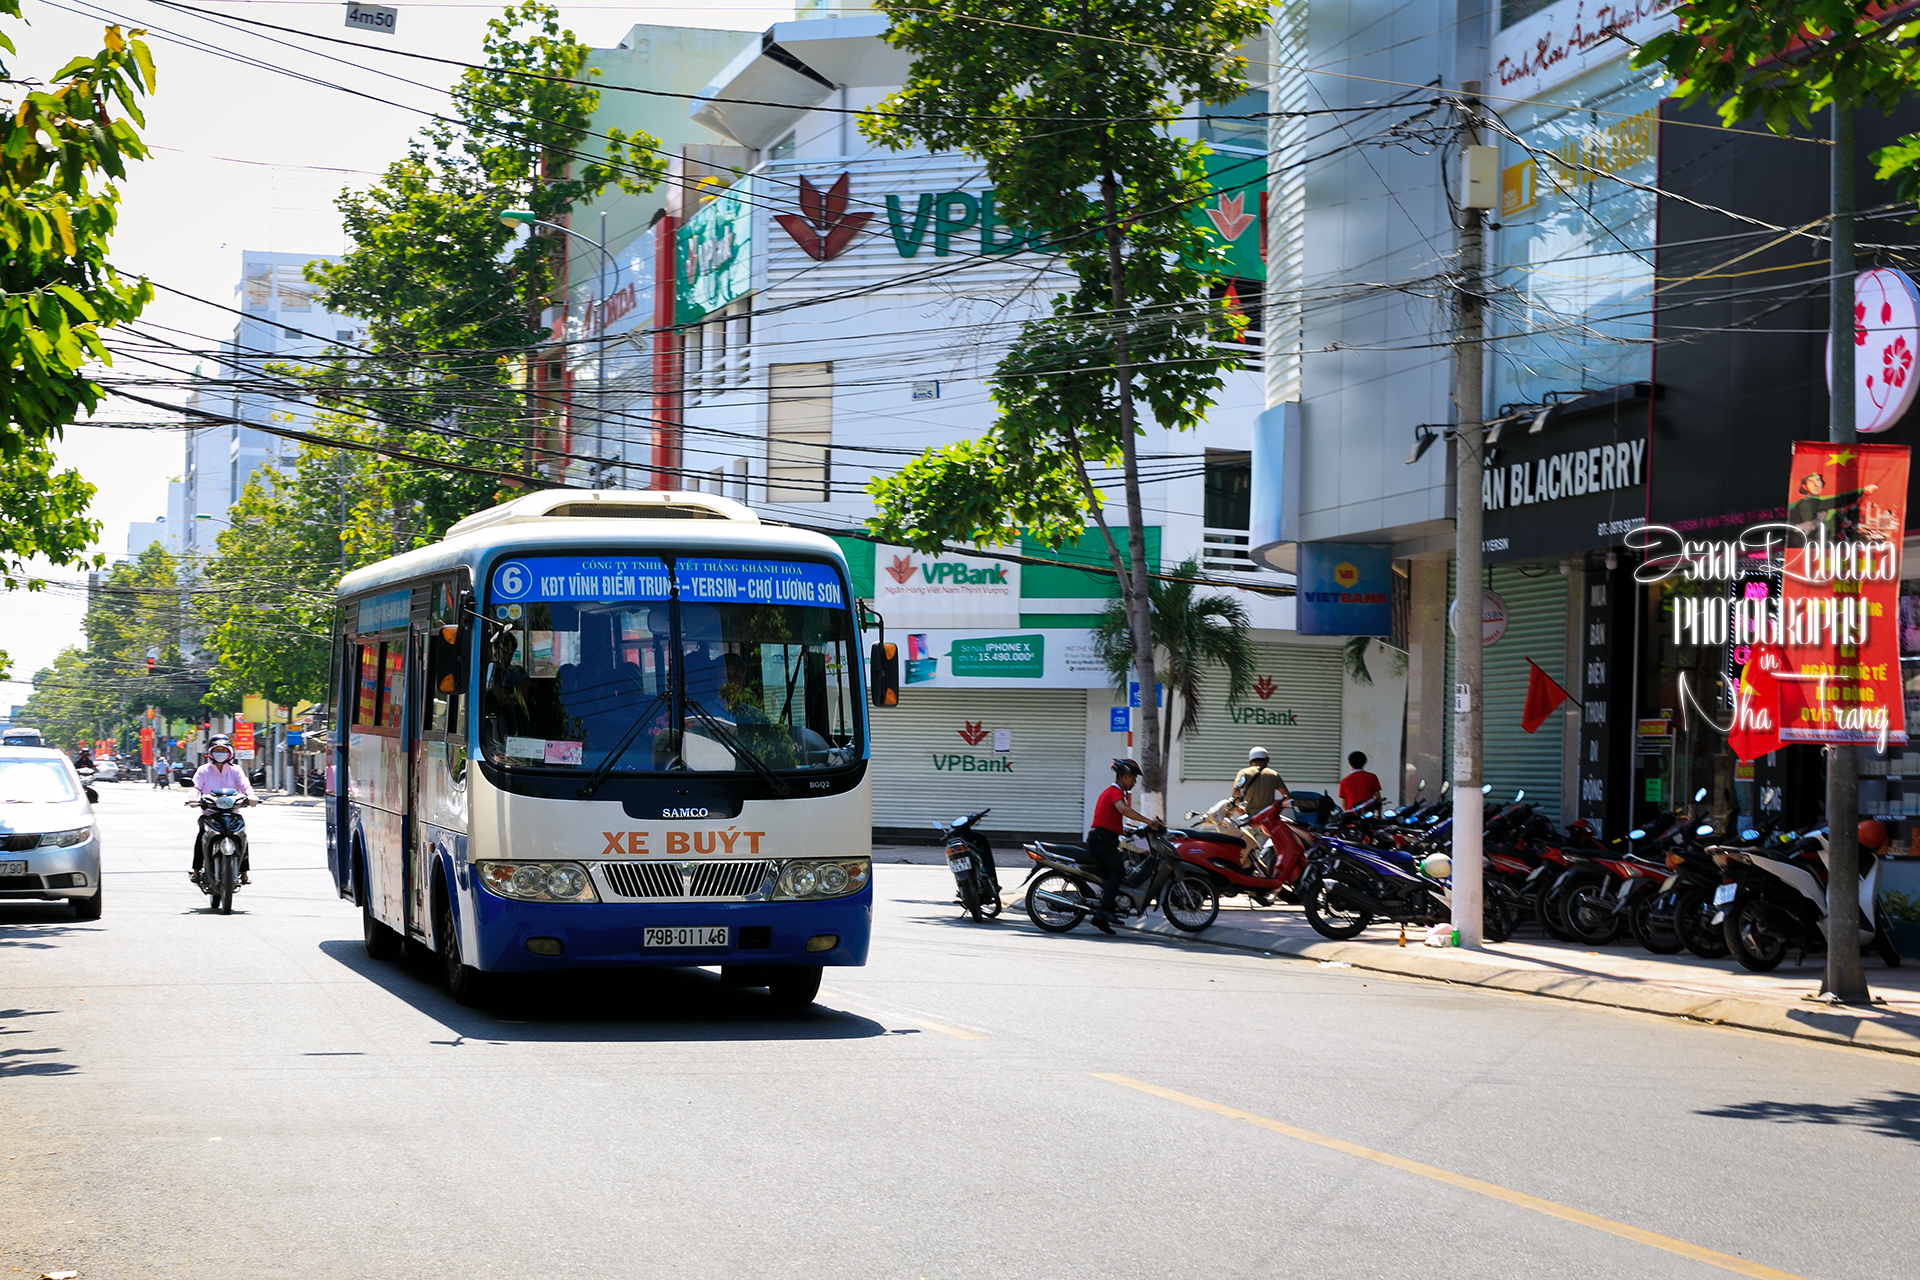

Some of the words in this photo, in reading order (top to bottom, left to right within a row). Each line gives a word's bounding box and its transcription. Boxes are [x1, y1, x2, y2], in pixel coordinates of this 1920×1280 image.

[349, 8, 394, 28] 4m50
[1510, 438, 1646, 506] BLACKBERRY
[582, 559, 612, 570] CÔNG
[615, 561, 628, 570] TY
[631, 561, 661, 570] TNHH
[702, 559, 739, 572] THẮNG
[741, 562, 778, 574] KHÁNH
[781, 564, 803, 575] HÒA
[922, 563, 1009, 585] VPBank
[1338, 569, 1355, 580] VB
[502, 566, 523, 594] 6
[541, 576, 565, 596] KĐT
[568, 572, 599, 596] VĨNH
[691, 577, 737, 598] YERSIN
[747, 576, 773, 604] CHỢ
[776, 578, 815, 602] LƯƠNG
[818, 581, 841, 604] SƠN
[1304, 592, 1389, 604] VIETBANK
[985, 643, 1022, 652] IPHONE
[1023, 643, 1032, 652] X
[1843, 684, 1875, 704] ĐỘNG
[1230, 706, 1298, 727] VPBank
[933, 754, 1014, 773] VPBank
[662, 808, 709, 818] SAMCO
[602, 832, 650, 855] XE
[666, 825, 766, 855] BUÝT
[645, 928, 727, 945] 79B-011.46
